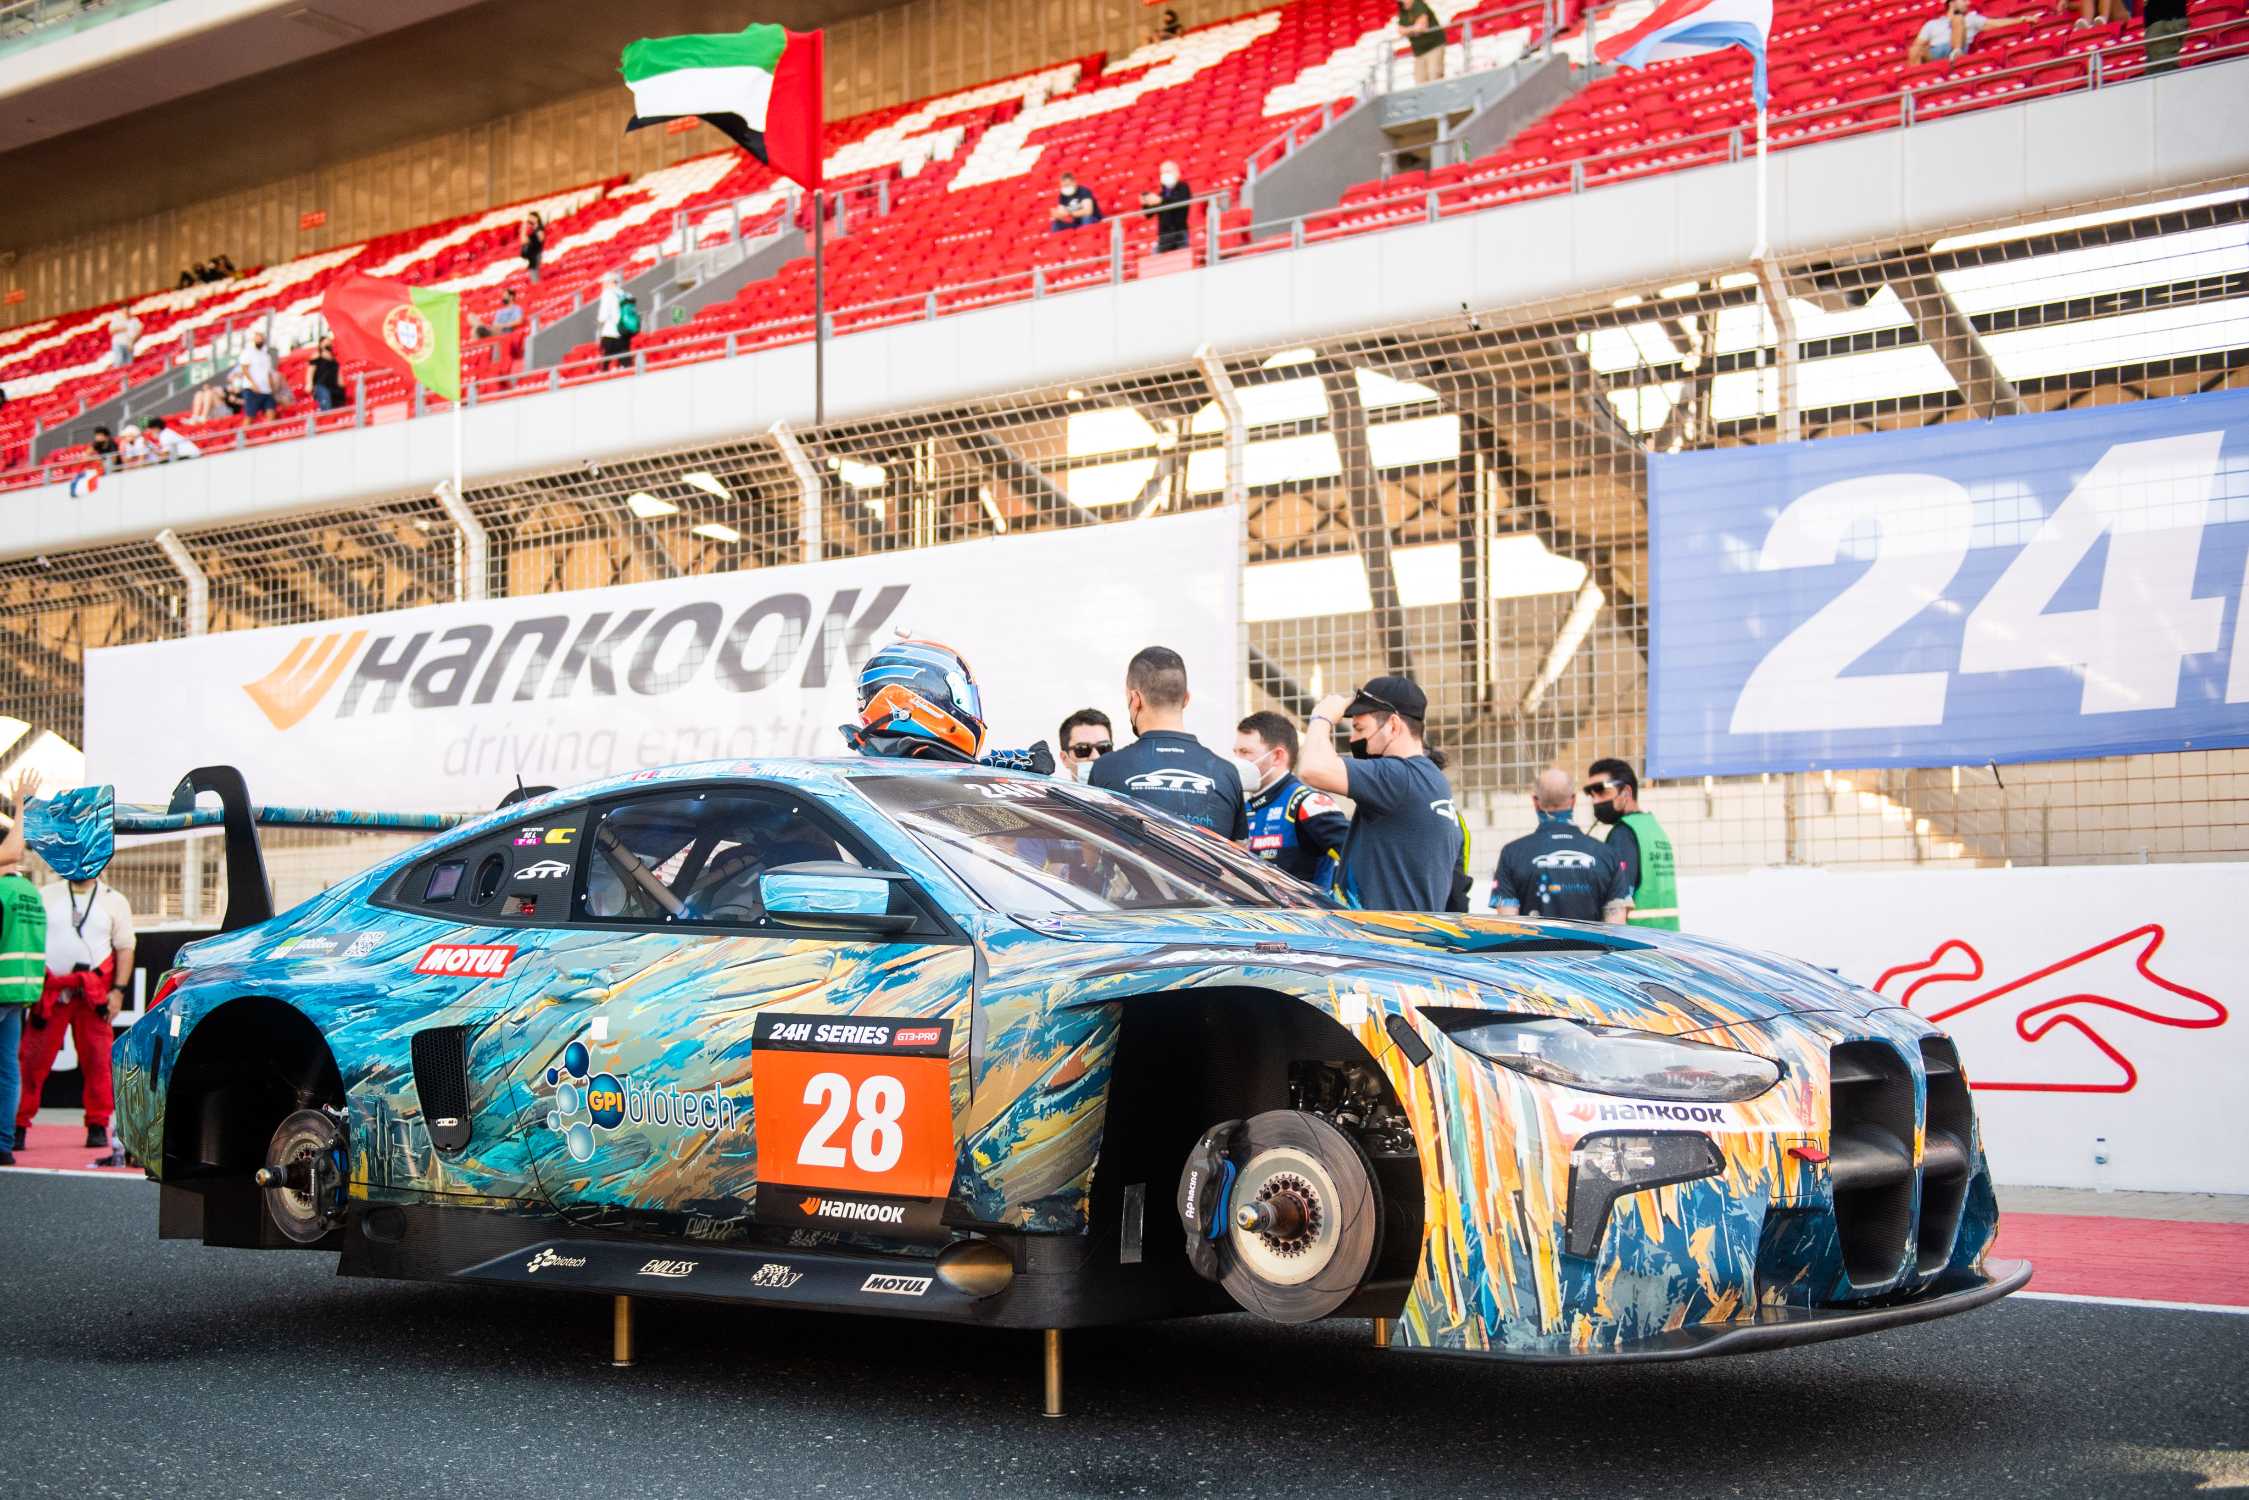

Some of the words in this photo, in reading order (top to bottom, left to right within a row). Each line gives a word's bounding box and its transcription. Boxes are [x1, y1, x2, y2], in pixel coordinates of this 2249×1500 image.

[1729, 431, 2249, 734] 24
[443, 716, 618, 778] driving
[419, 948, 512, 975] MOTUL
[769, 1022, 812, 1042] 24H
[815, 1024, 890, 1046] SERIES
[896, 1031, 938, 1043] GT3-PRO
[589, 1090, 624, 1114] GPI
[626, 1074, 736, 1132] biotech
[796, 1072, 906, 1173] 28
[1187, 1170, 1198, 1202] RACING
[1185, 1202, 1196, 1219] AP
[552, 1255, 587, 1267] biotech
[640, 1258, 699, 1275] ENDLESS
[867, 1276, 928, 1294] MOTUL
